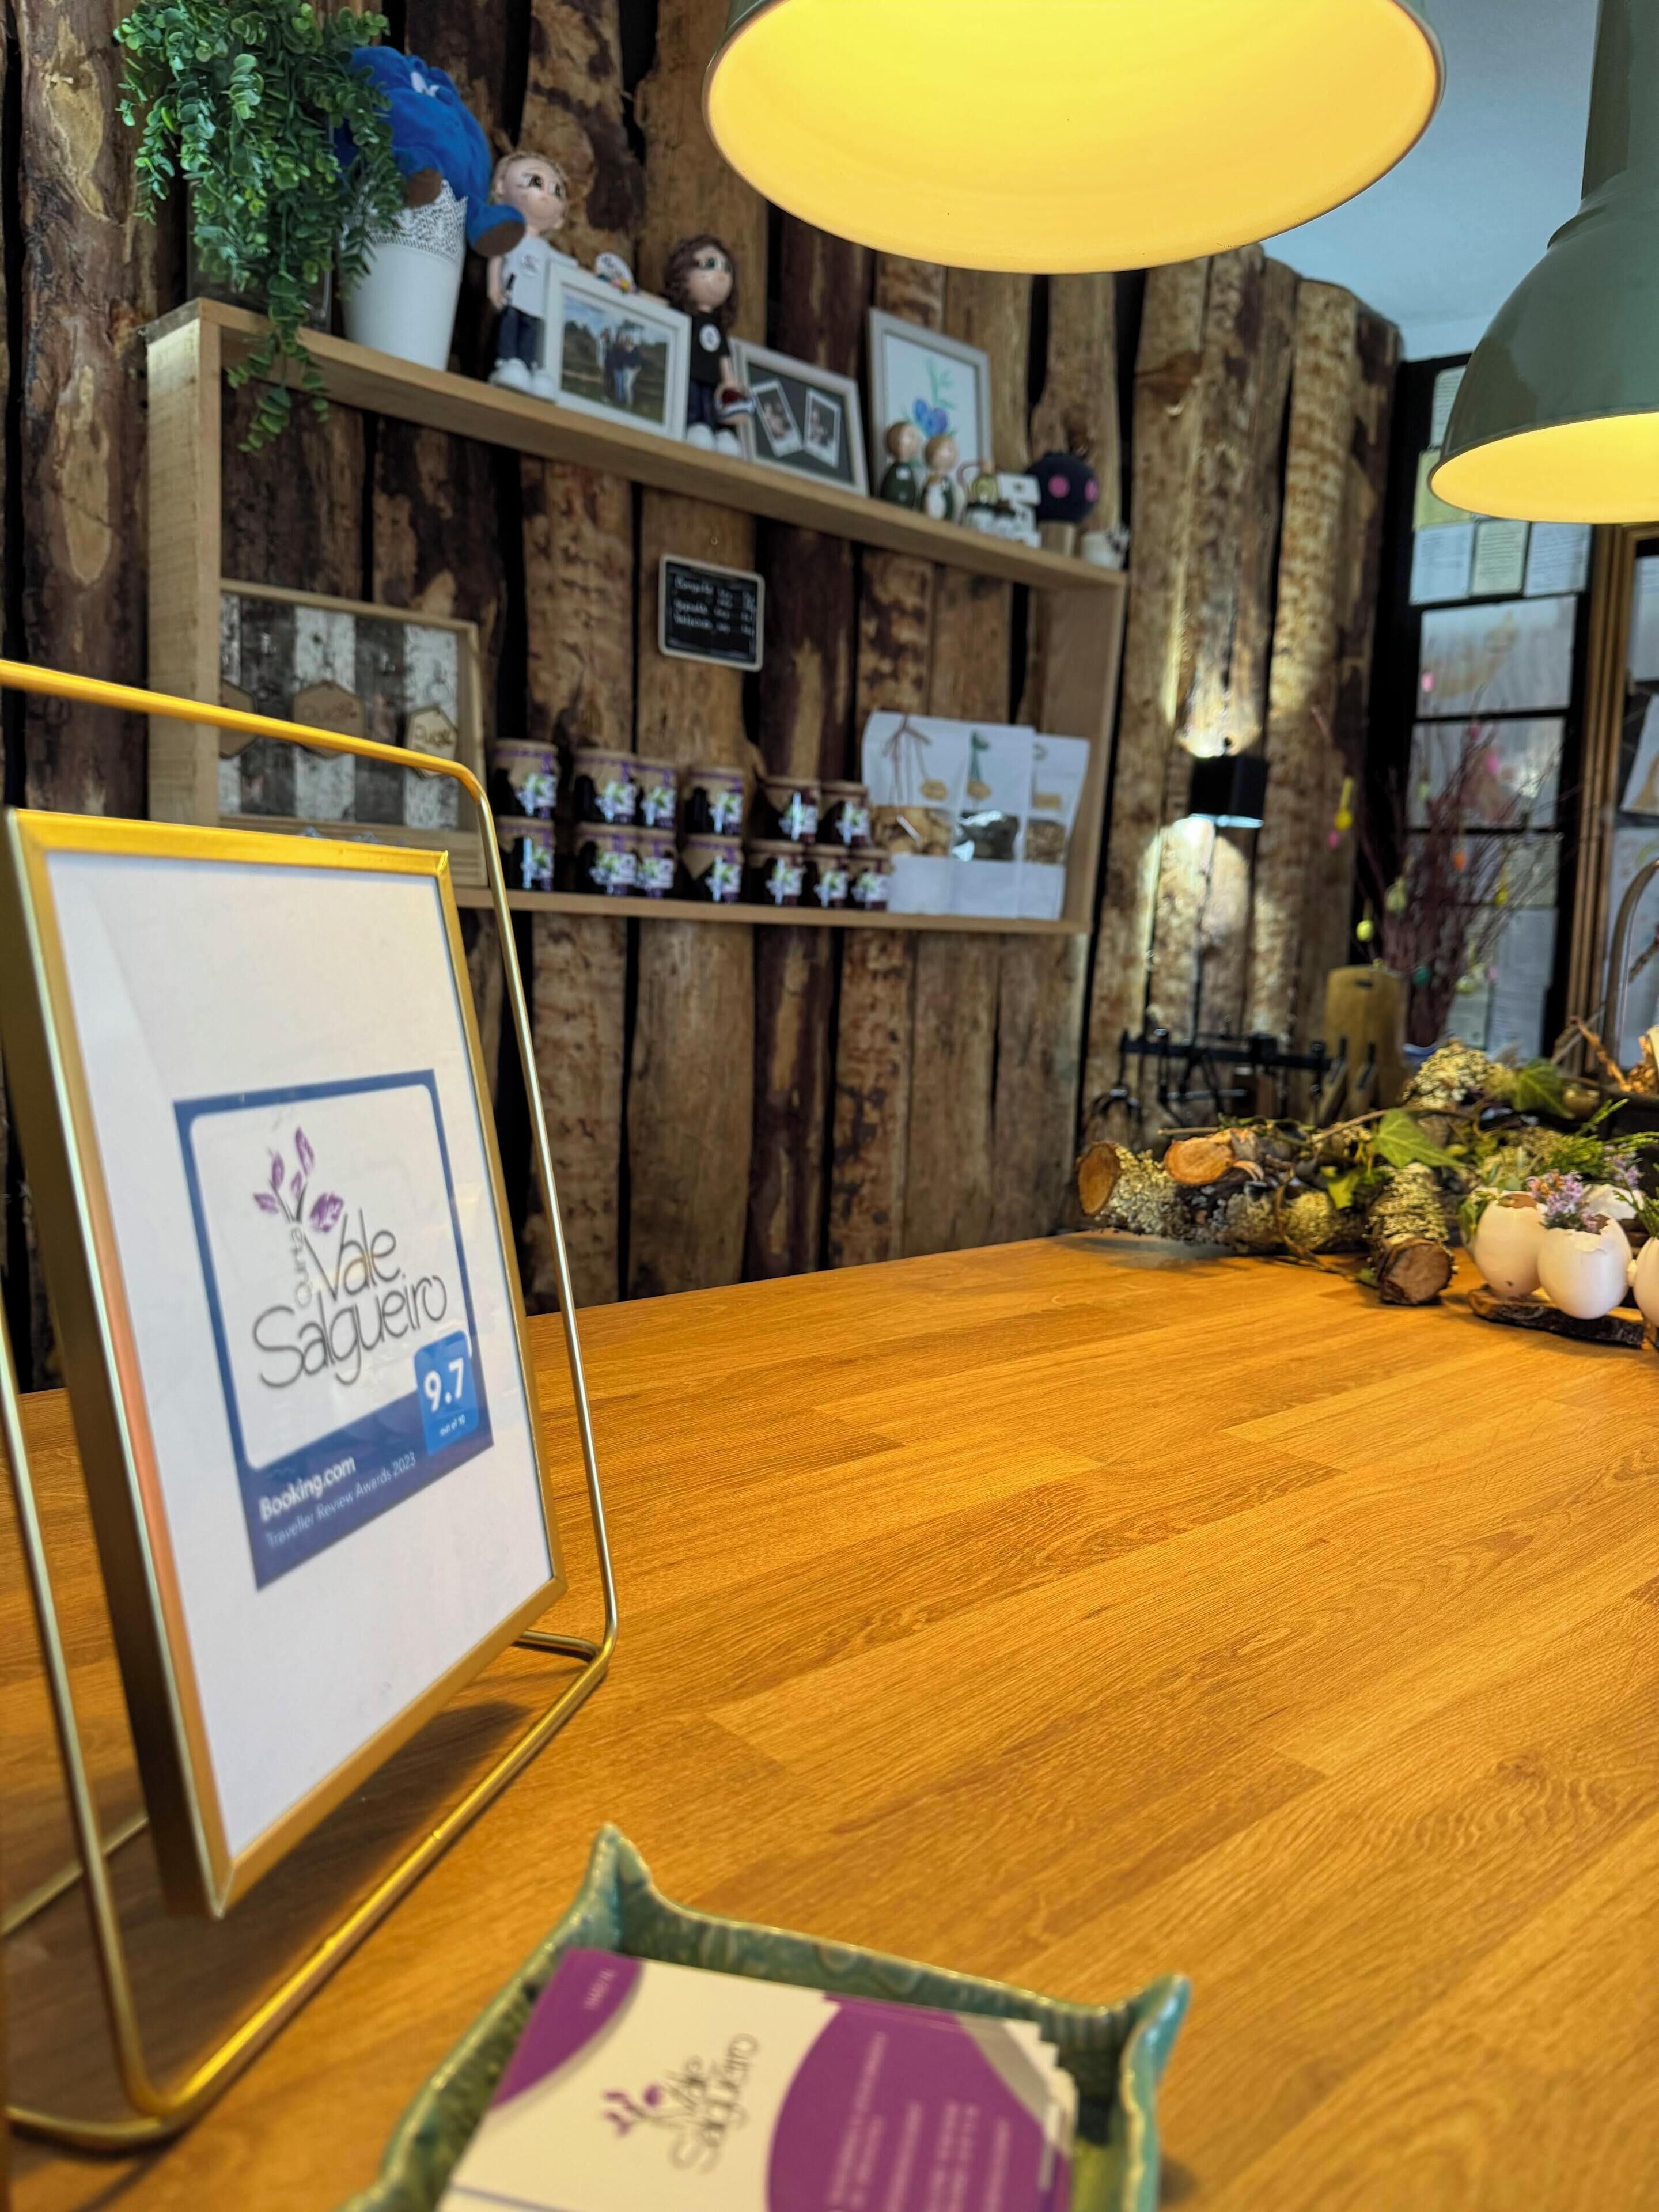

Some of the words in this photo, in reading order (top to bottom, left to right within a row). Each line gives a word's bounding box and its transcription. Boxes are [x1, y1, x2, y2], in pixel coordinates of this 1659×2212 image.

[302, 1207, 400, 1301] Vale
[253, 1274, 447, 1389] Salgueiro
[423, 1357, 464, 1412] 9.7
[260, 1456, 357, 1522] Booking.com
[266, 1513, 315, 1548] Traveller
[316, 1490, 353, 1520] Review
[355, 1467, 392, 1498] Awards
[392, 1451, 416, 1476] 2023
